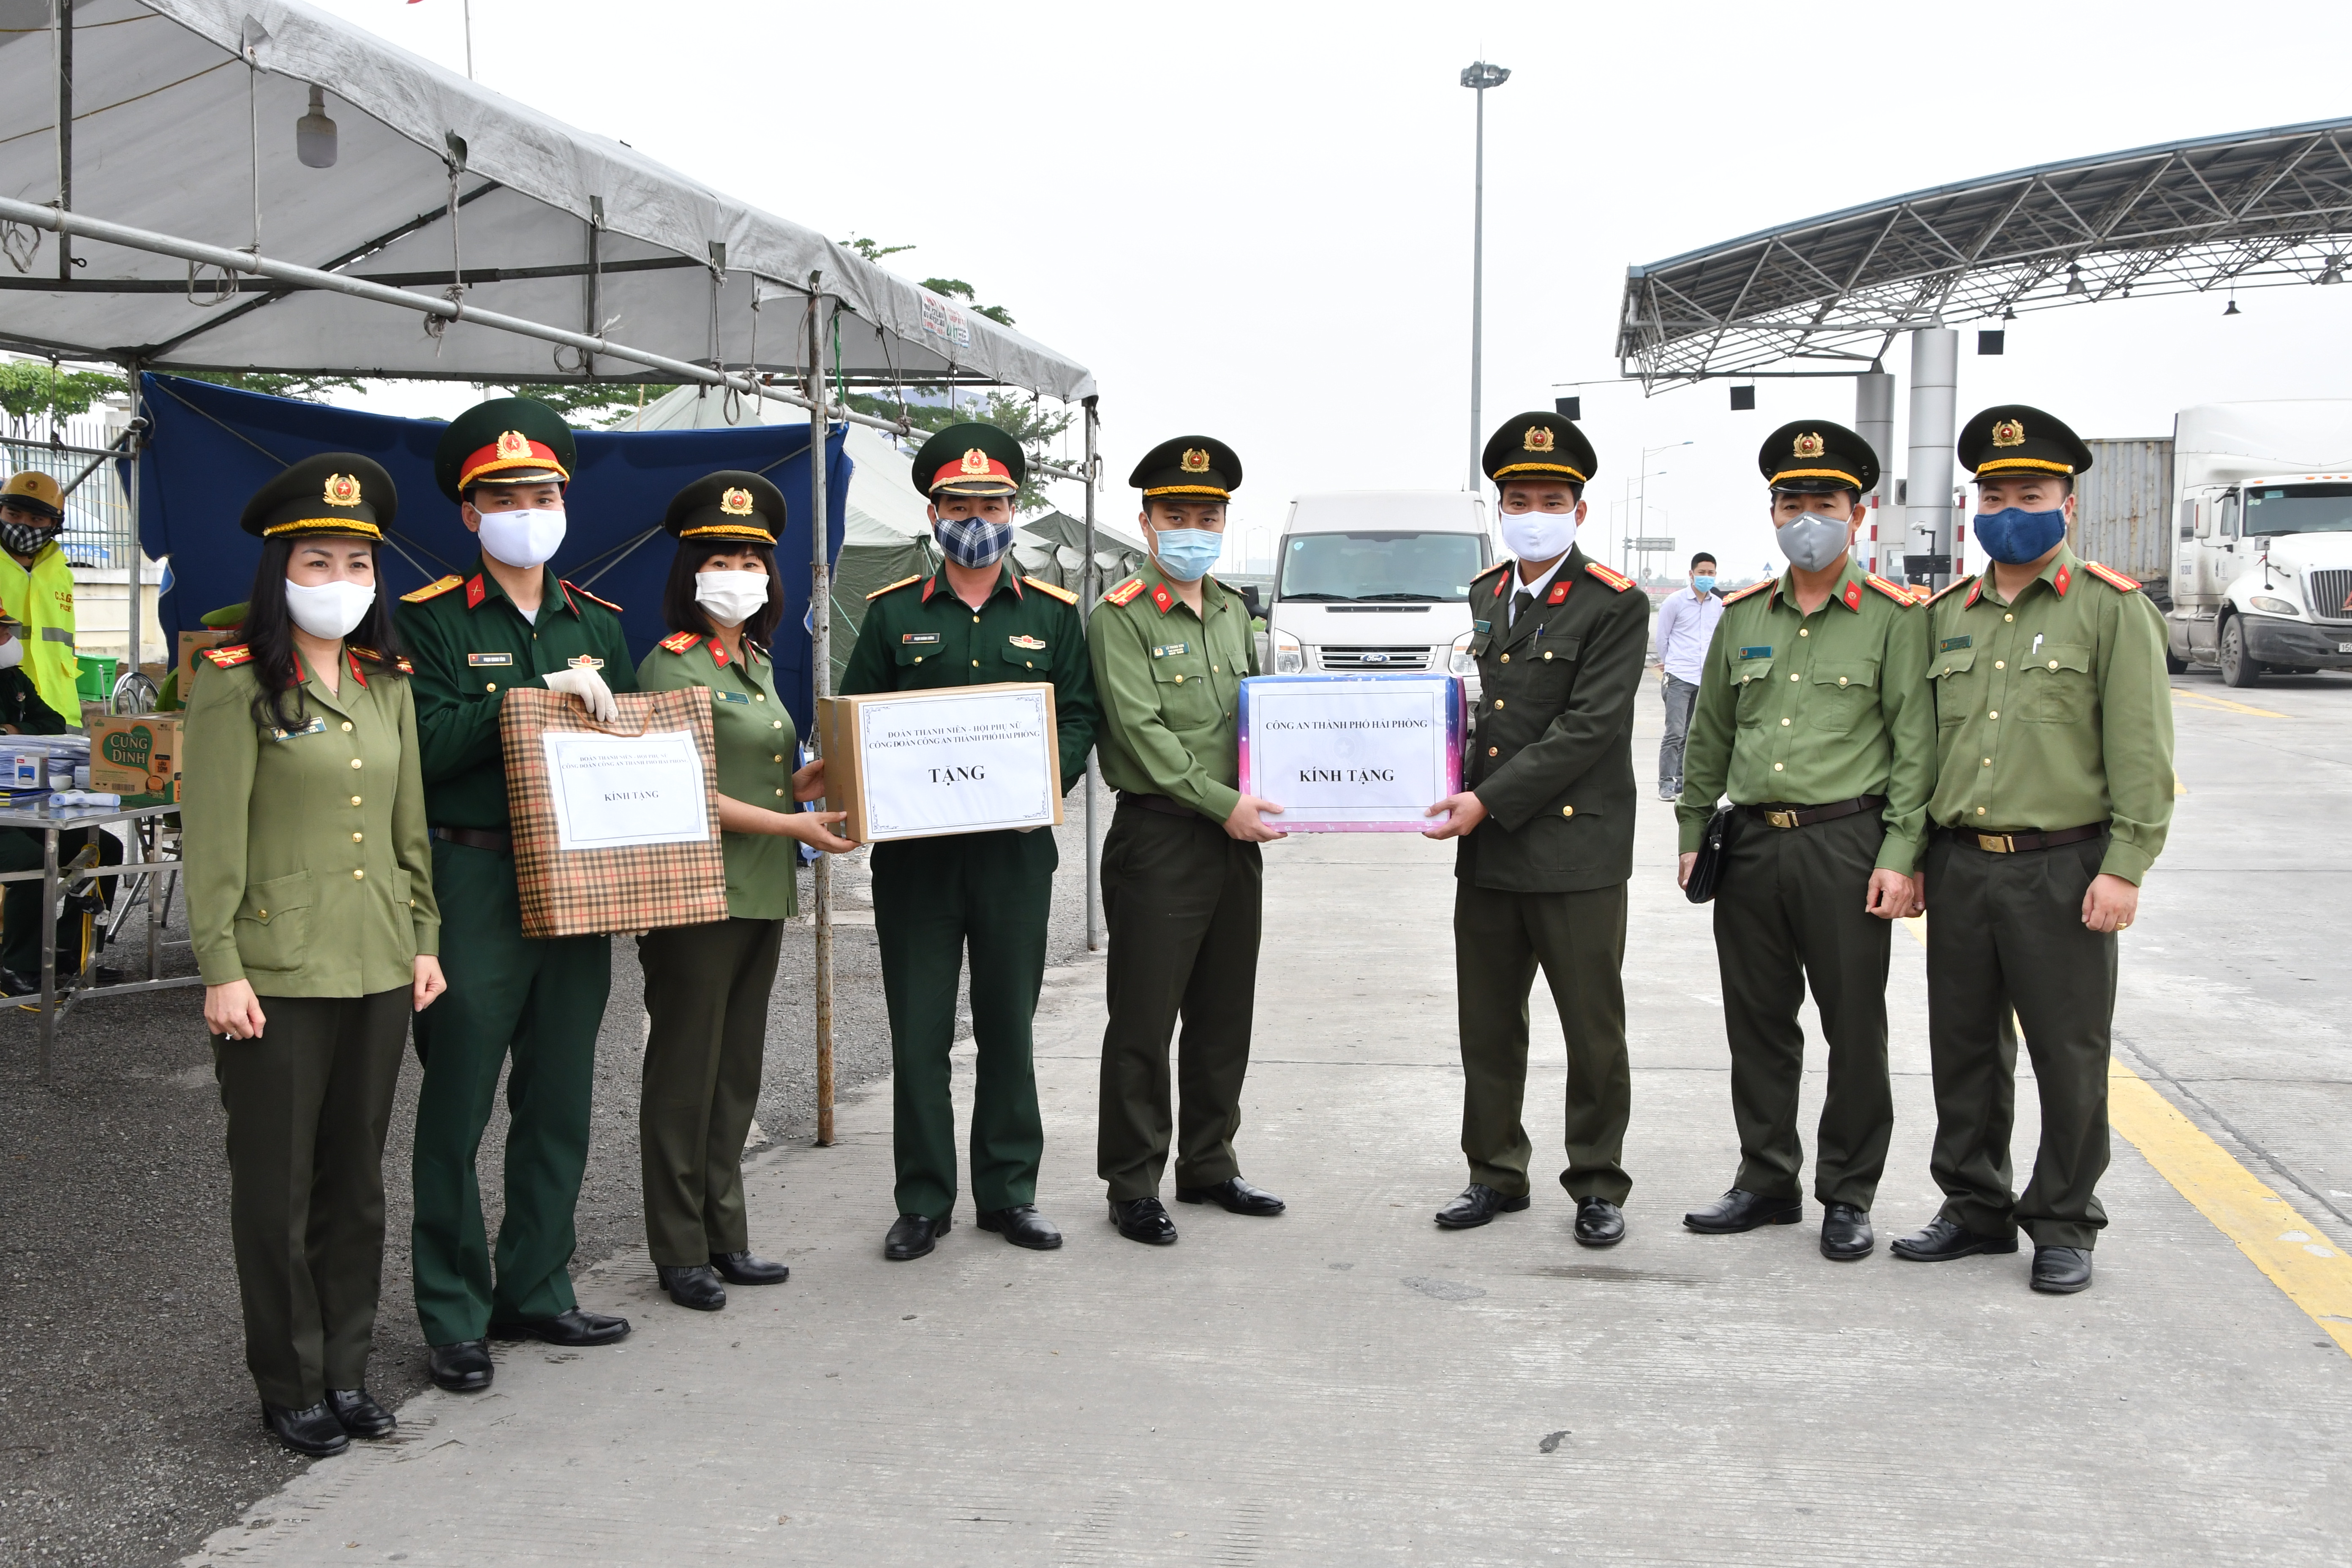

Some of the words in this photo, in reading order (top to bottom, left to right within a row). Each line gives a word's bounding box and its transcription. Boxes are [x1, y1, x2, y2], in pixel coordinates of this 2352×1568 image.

[914, 728, 944, 736] THANH
[947, 725, 966, 733] NIÊN
[974, 724, 988, 732] HỘI
[1010, 721, 1021, 729] NỮ
[1266, 720, 1294, 730] CÔNG
[1312, 719, 1347, 729] THÀNH
[1350, 719, 1370, 729] PHỐ
[1372, 718, 1389, 728] HẢI
[1392, 718, 1427, 728] PHÒNG
[110, 735, 148, 749] CUNG
[869, 740, 892, 749] CÔNG
[917, 737, 940, 745] CÔNG
[953, 734, 980, 743] THÀNH
[1014, 730, 1040, 738] PHÒNG
[112, 748, 146, 764] ĐÌNH
[928, 765, 985, 786] TẶNG
[1299, 766, 1342, 782] KÍNH
[1347, 768, 1394, 785] TẶNG
[604, 791, 630, 801] KÍNH
[632, 790, 659, 801] TẶNG
